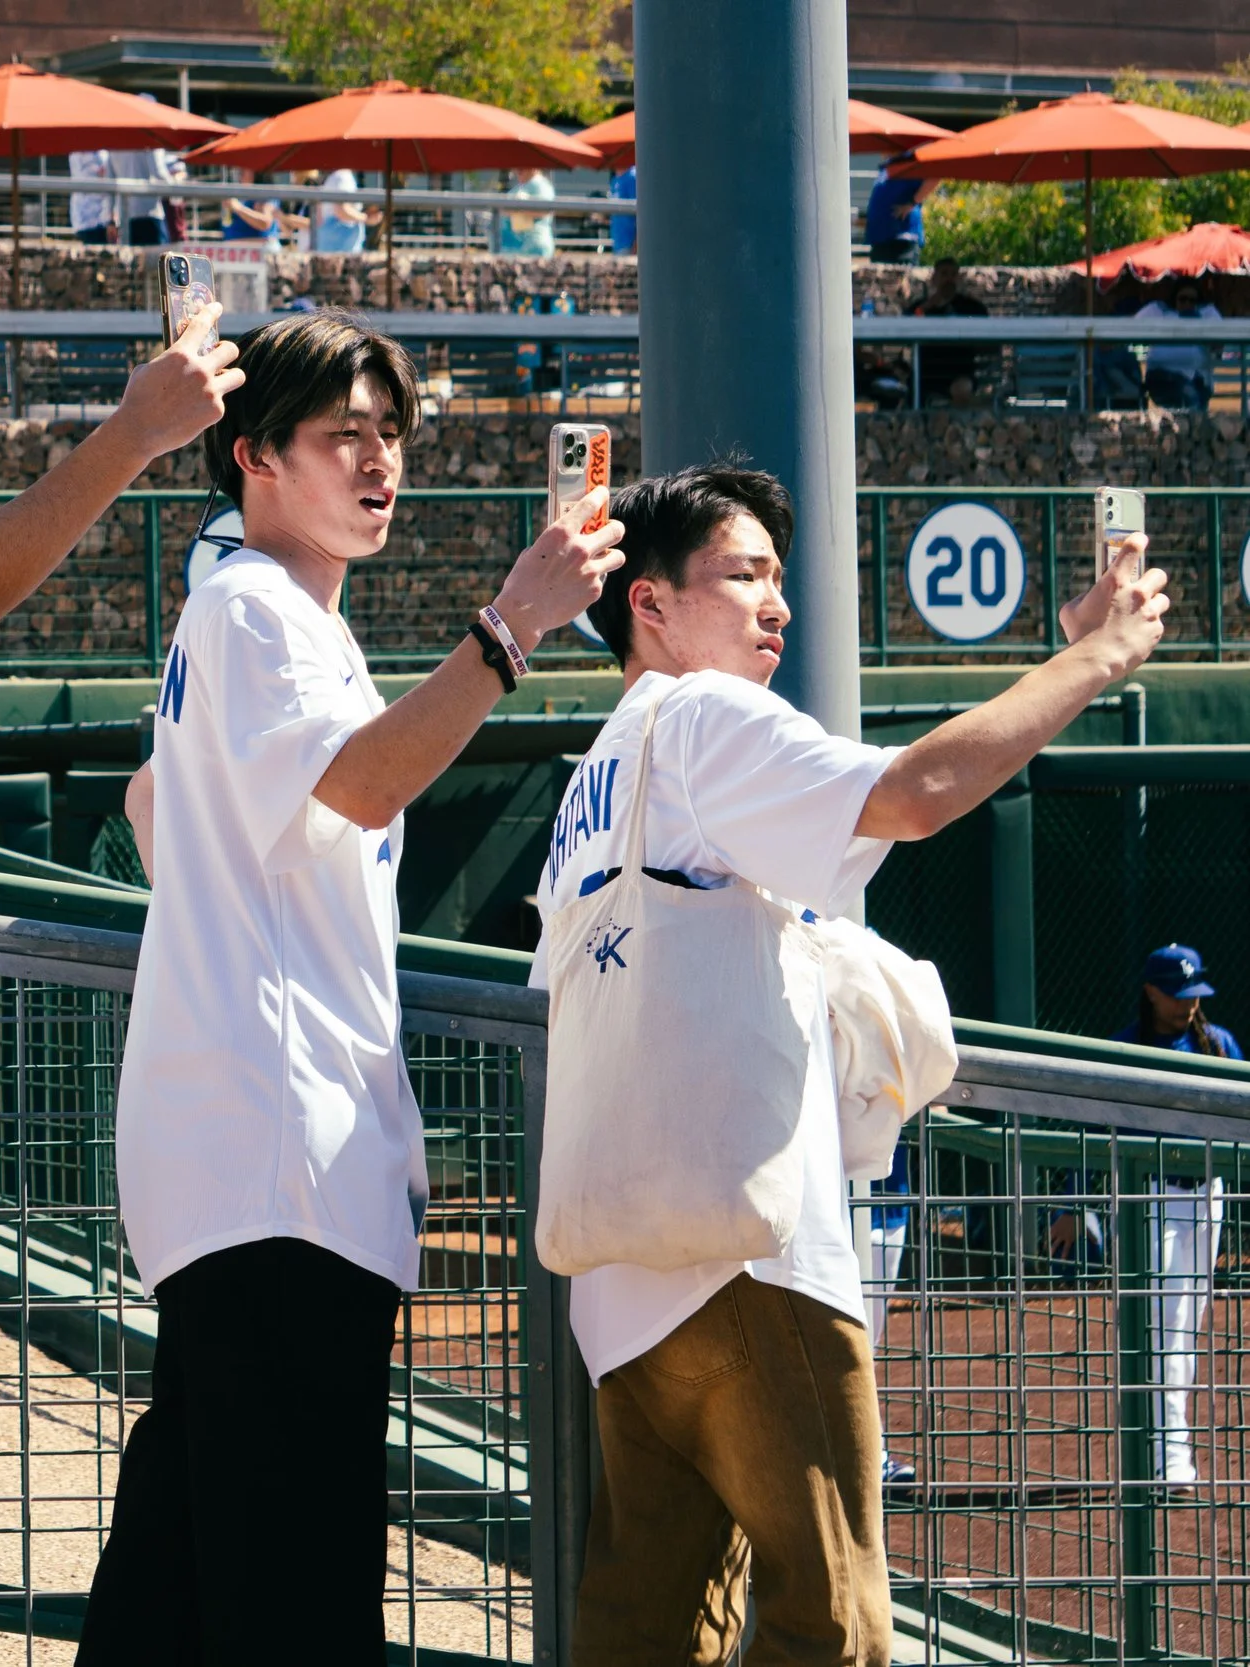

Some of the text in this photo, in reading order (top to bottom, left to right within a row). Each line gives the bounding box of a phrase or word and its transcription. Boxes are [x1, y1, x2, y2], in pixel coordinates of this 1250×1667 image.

[926, 536, 1006, 606] 20
[507, 643, 520, 660] SUN
[549, 758, 620, 896] OHTANI
